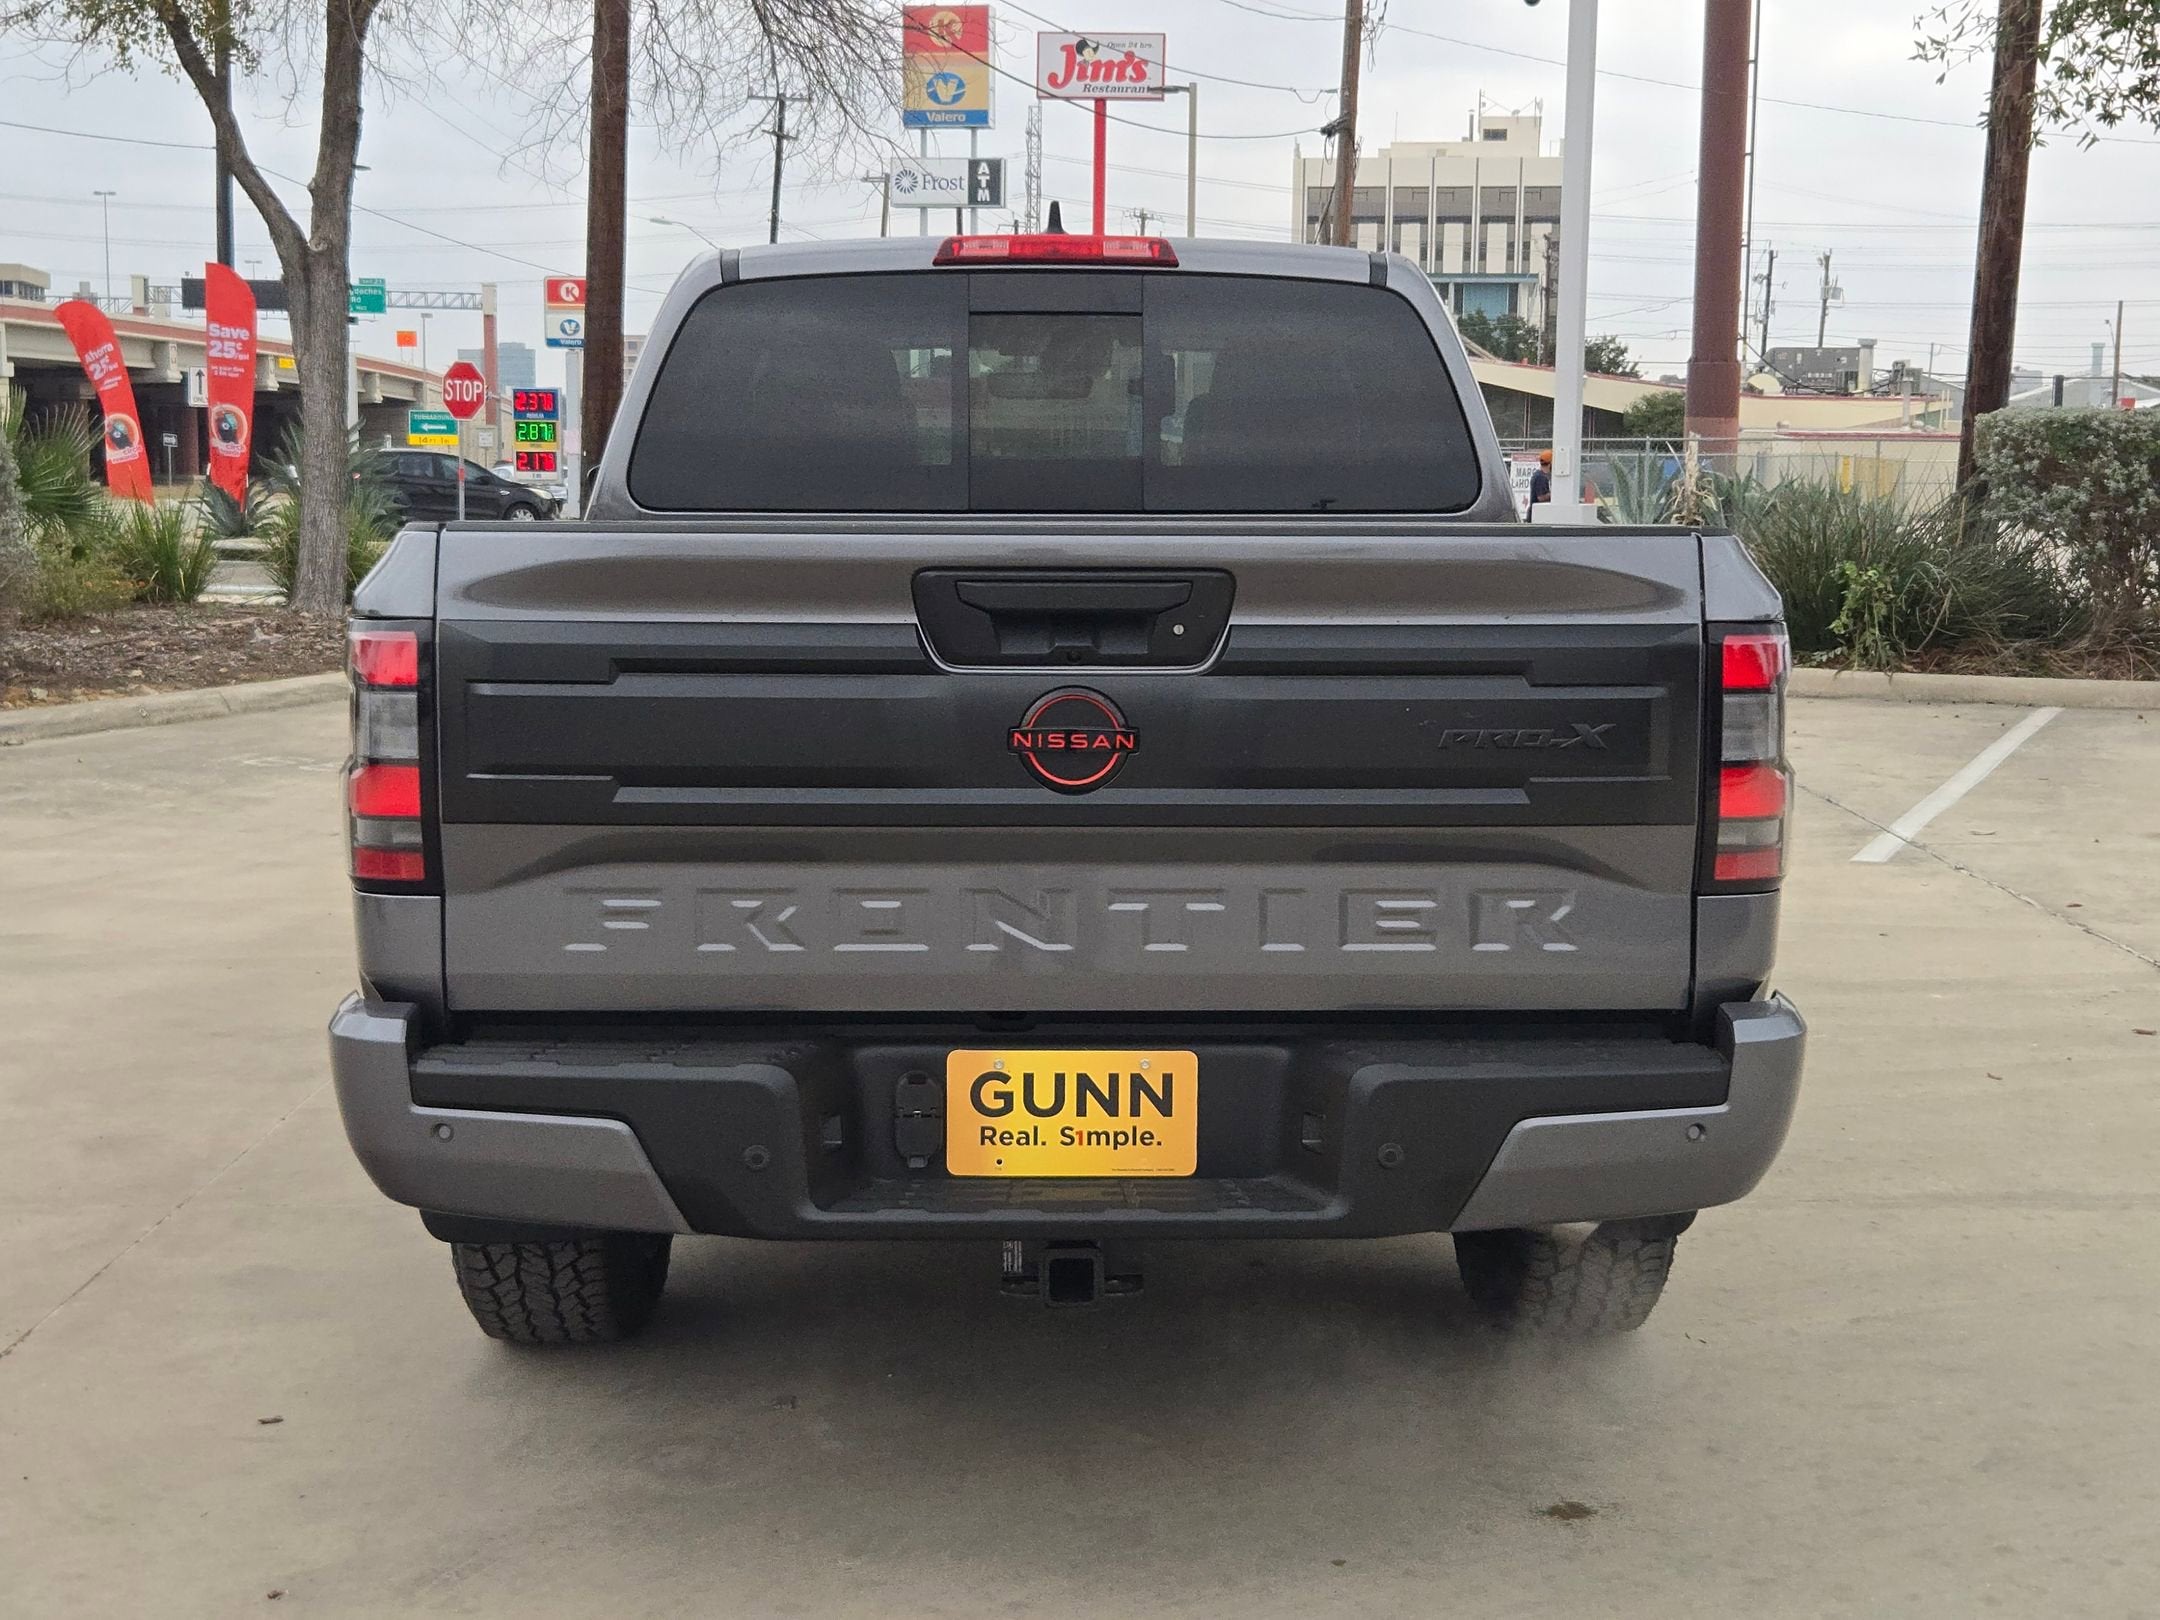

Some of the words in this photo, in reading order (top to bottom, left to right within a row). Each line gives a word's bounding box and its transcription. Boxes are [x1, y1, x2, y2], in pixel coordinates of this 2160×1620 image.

[1047, 43, 1149, 89] Jim's
[1082, 83, 1152, 94] Restaurant
[926, 112, 966, 122] Valero
[921, 171, 965, 191] Frost
[977, 162, 990, 202] ATM
[209, 323, 250, 340] Save
[445, 380, 483, 402] STOP
[1012, 732, 1136, 750] NISSAN
[1437, 722, 1617, 750] PRO-X
[563, 887, 1580, 952] FRONTIER
[970, 1070, 1174, 1118] GUNN
[980, 1126, 1047, 1146] Real.
